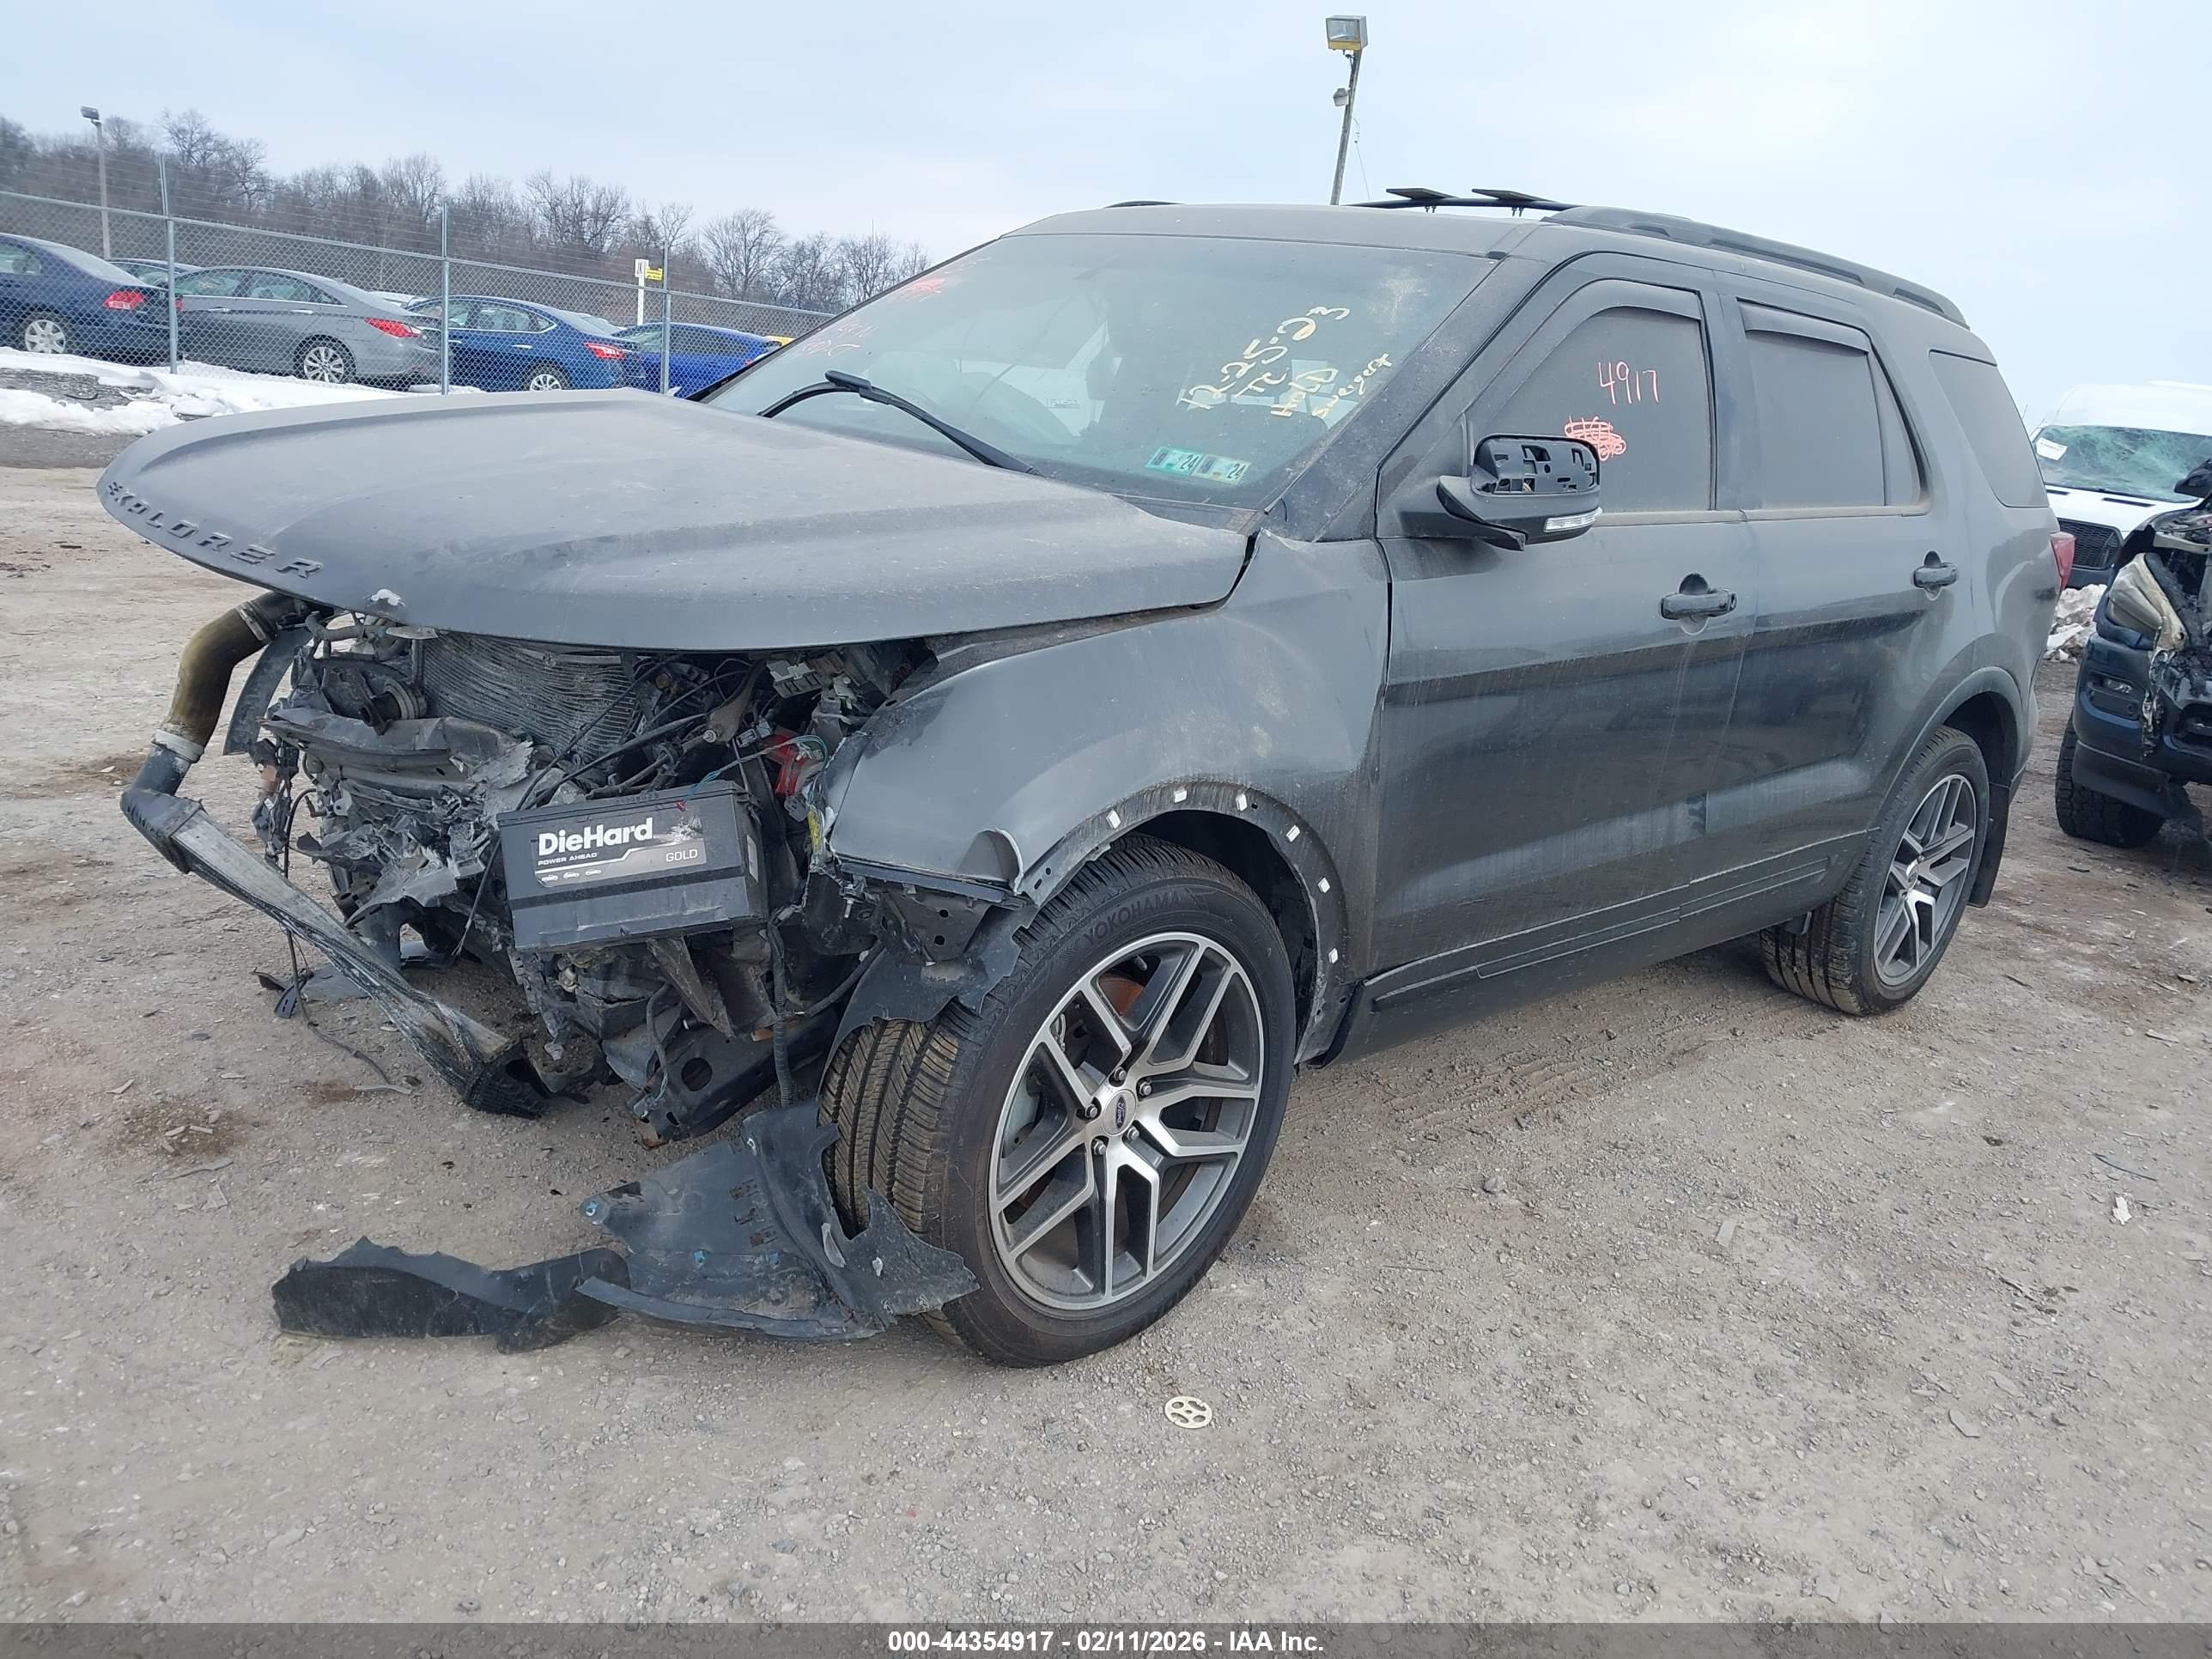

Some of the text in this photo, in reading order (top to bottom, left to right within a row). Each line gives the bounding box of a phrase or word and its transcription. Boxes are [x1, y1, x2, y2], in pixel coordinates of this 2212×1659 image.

[1598, 361, 1659, 404] 4917
[1180, 453, 1200, 471] 24
[538, 817, 653, 856] DieHard
[538, 852, 599, 866] POWER AHEAD
[665, 848, 698, 863] GOLD
[1083, 889, 1182, 945] YOKOHAMA
